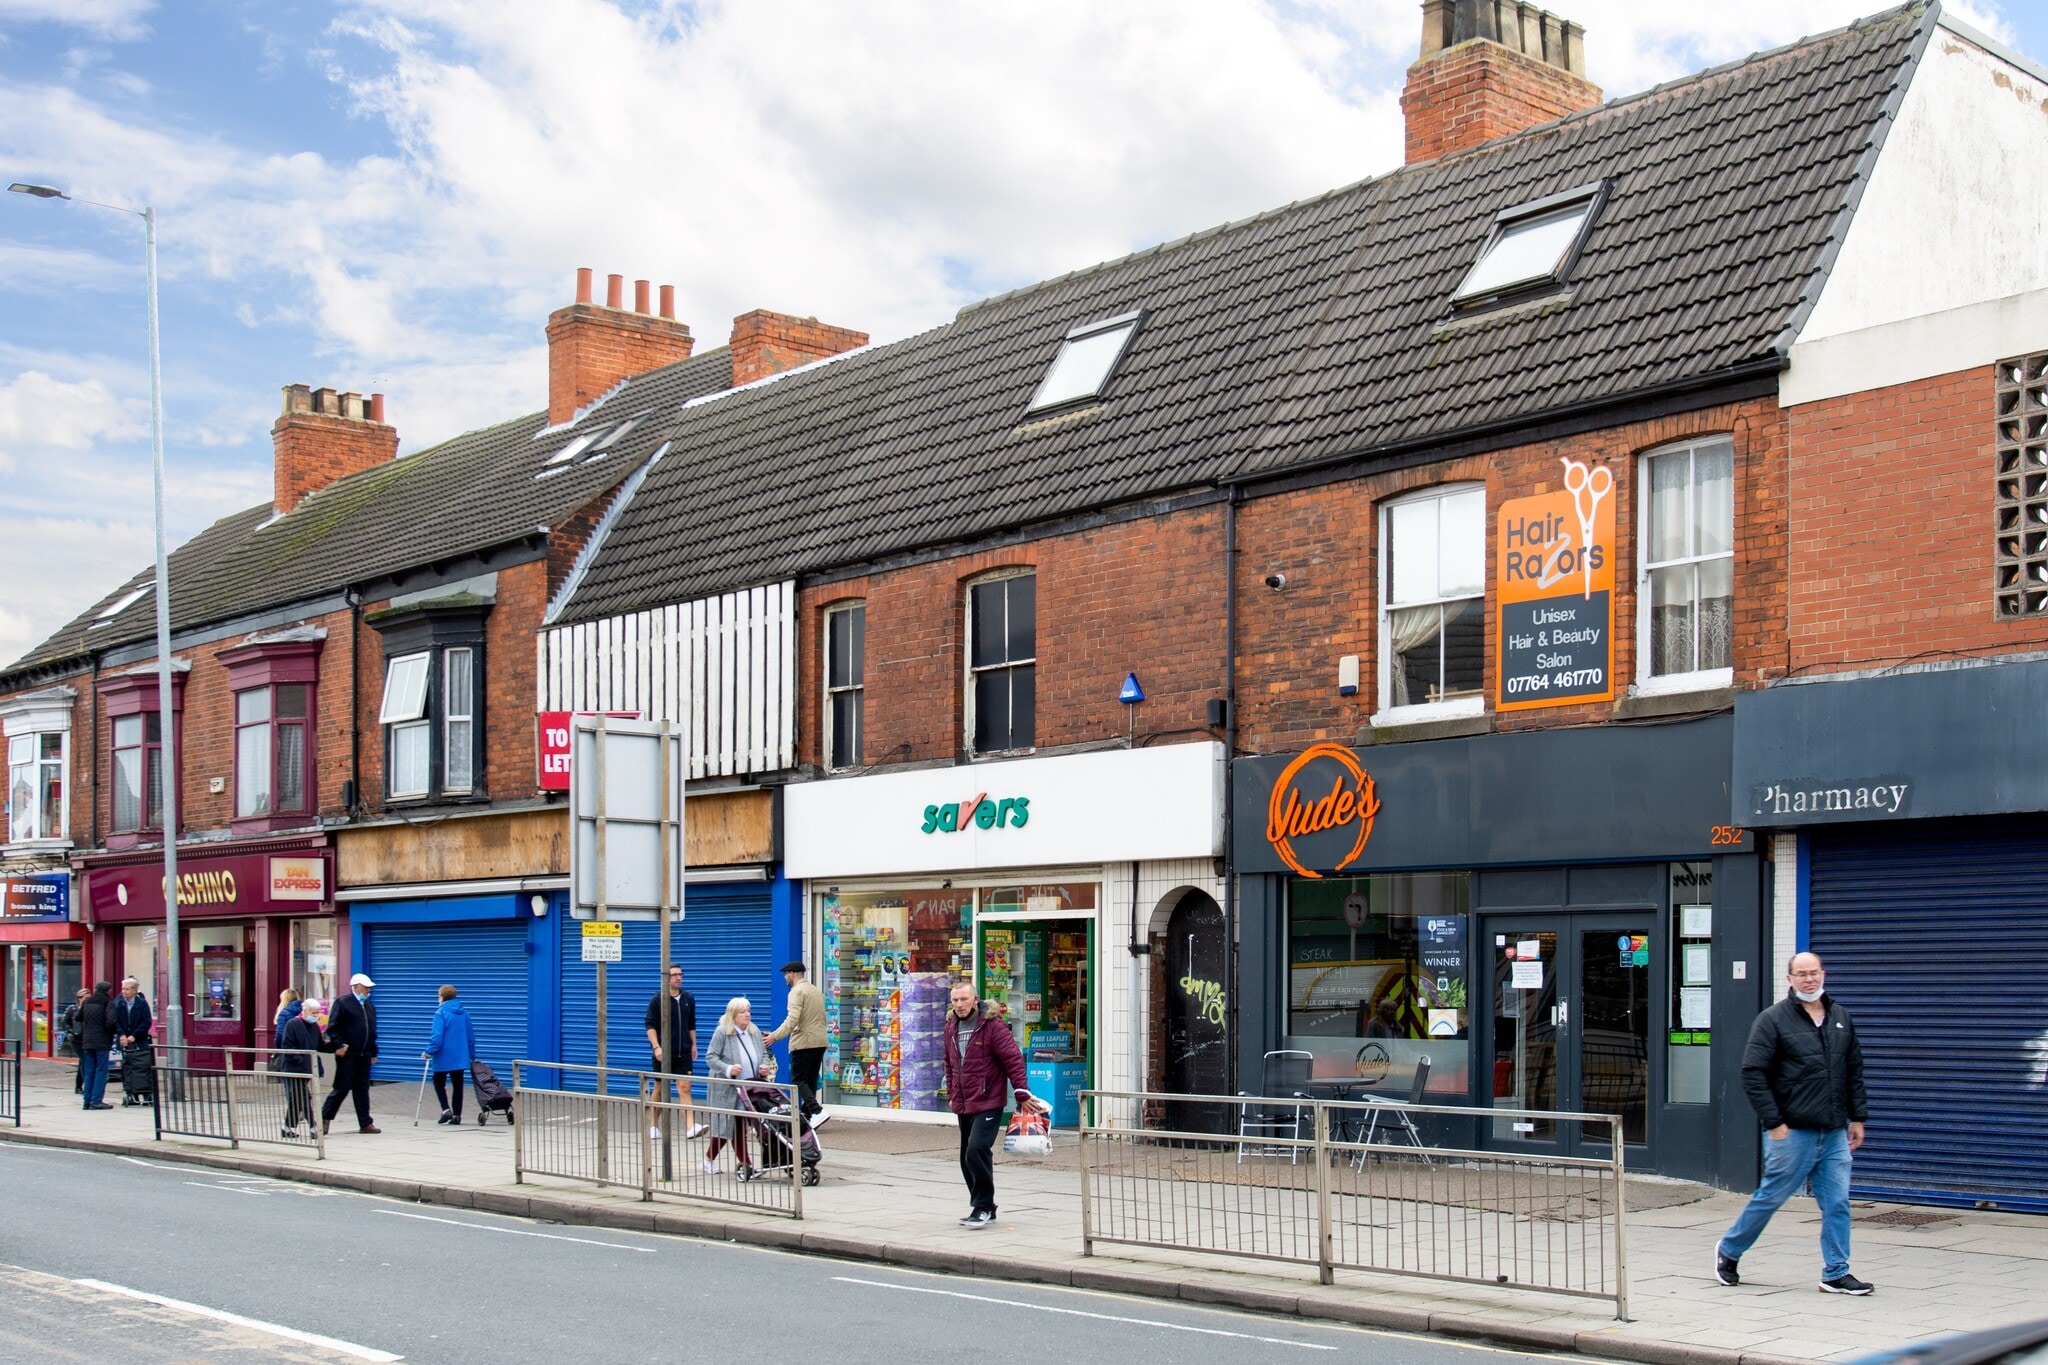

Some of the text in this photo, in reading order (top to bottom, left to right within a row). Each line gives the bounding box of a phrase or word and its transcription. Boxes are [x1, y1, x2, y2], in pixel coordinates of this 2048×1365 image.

[1507, 512, 1564, 548] Hair
[1532, 608, 1576, 625] Unisex
[1509, 627, 1601, 650] Hair & Beauty
[1536, 652, 1572, 669] Salon
[1507, 668, 1603, 693] 07764 461770
[545, 728, 569, 748] TO
[544, 753, 571, 773] LET
[920, 792, 1030, 834] savers
[1710, 825, 1743, 845] 252
[11, 884, 57, 894] BETFRED
[274, 879, 321, 890] EXPRESS
[11, 902, 57, 912] bonus king
[1300, 948, 1334, 961] STEAK
[1424, 957, 1461, 967] WINNER
[1316, 965, 1350, 980] NIGHT
